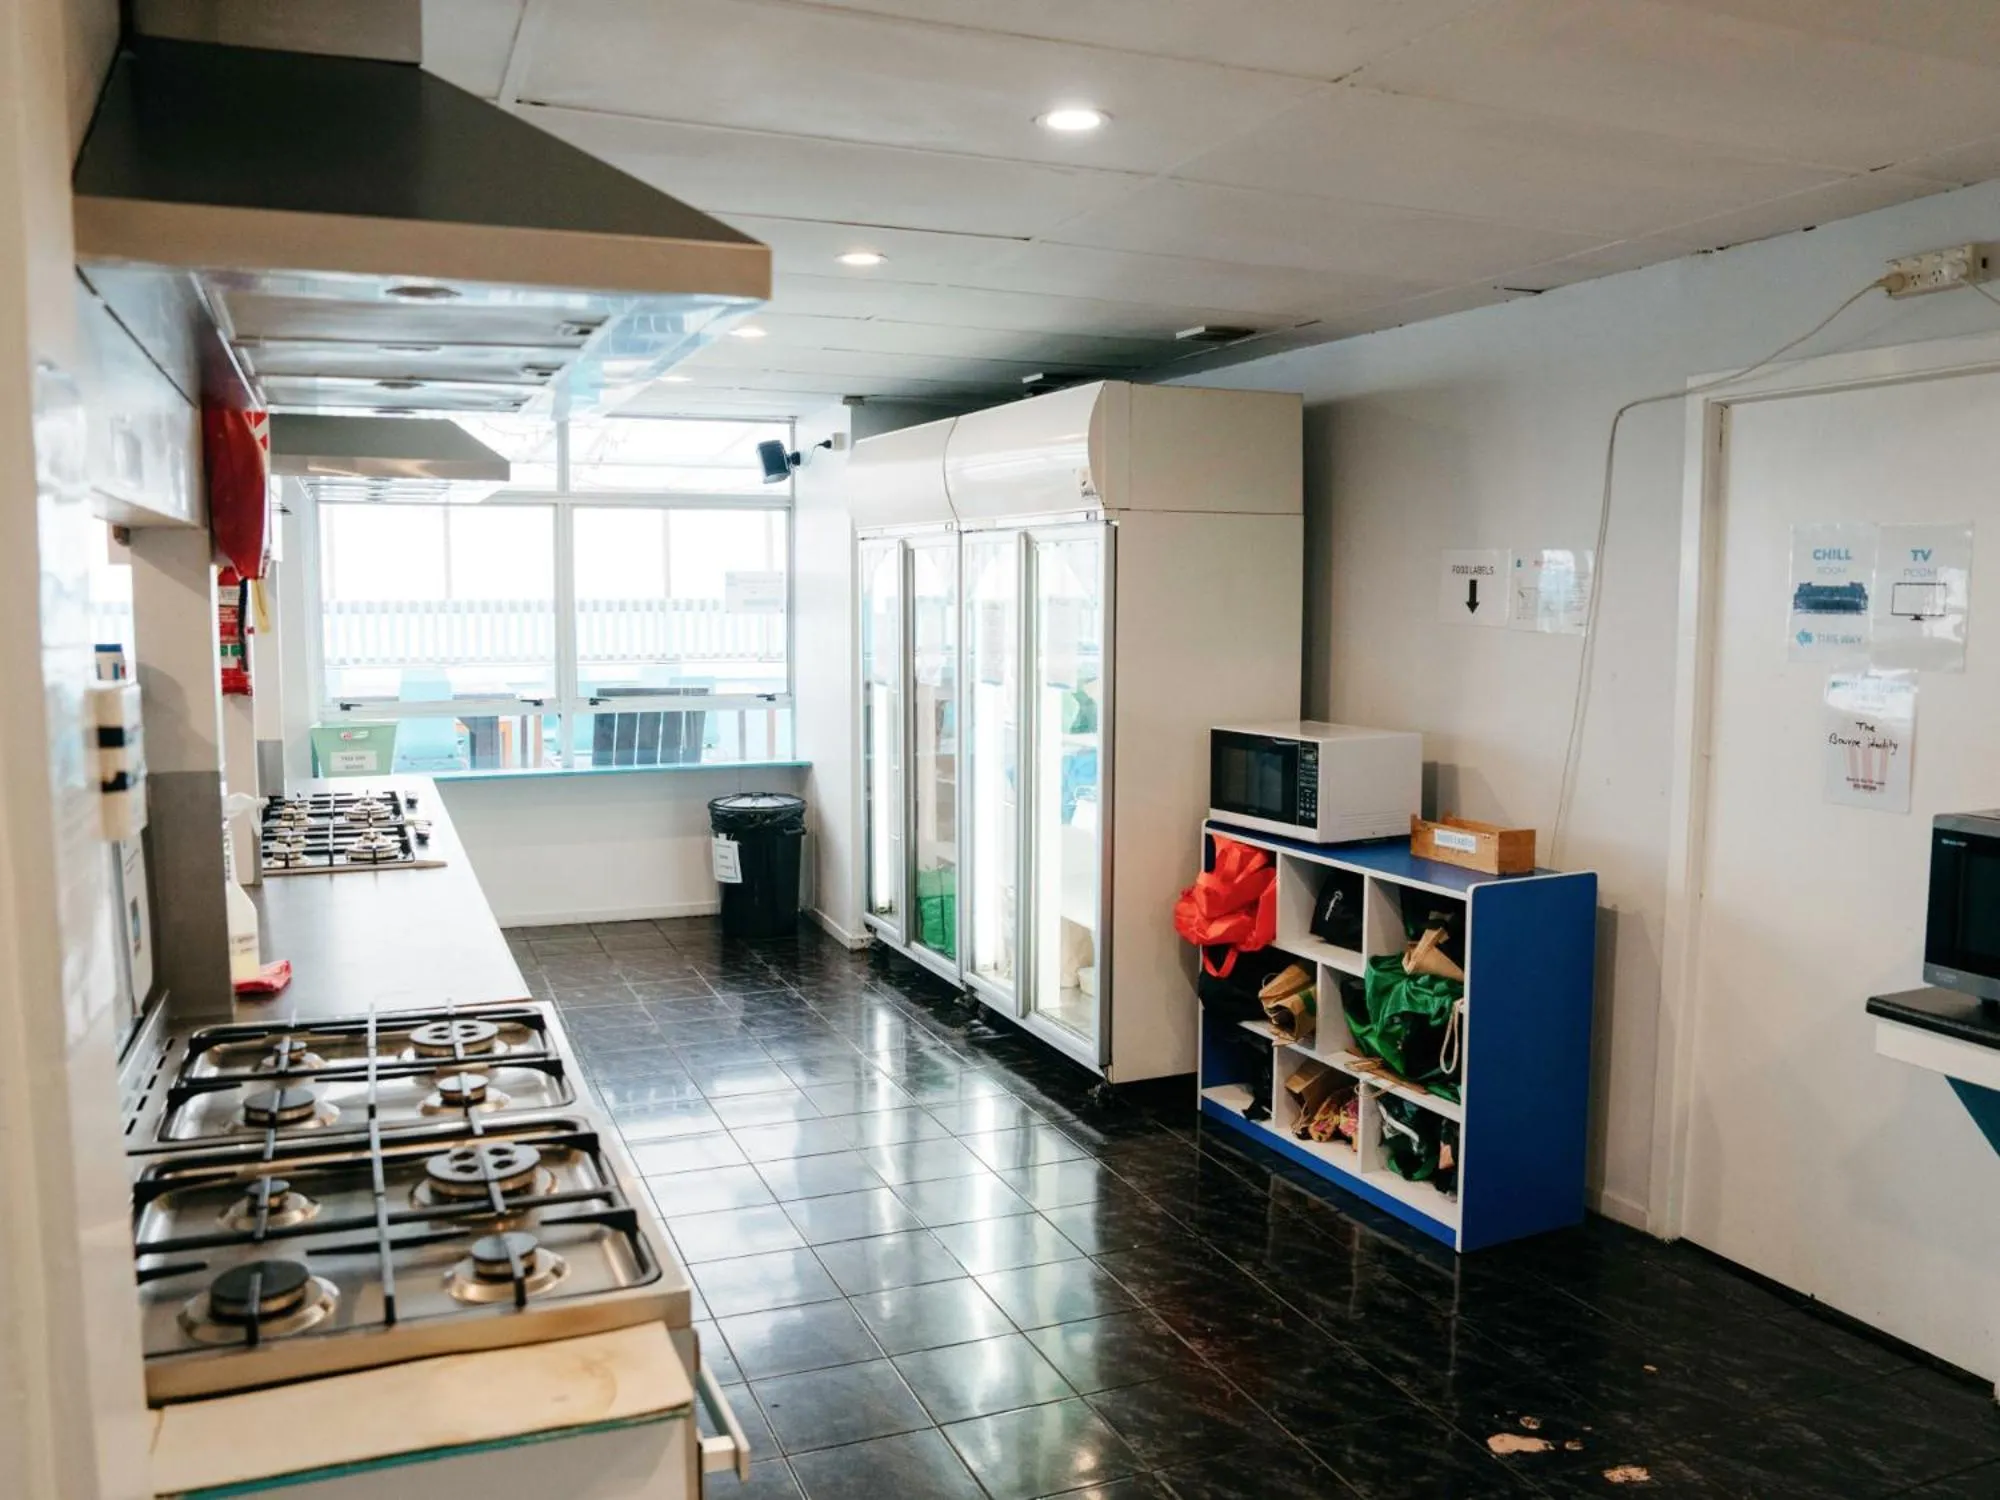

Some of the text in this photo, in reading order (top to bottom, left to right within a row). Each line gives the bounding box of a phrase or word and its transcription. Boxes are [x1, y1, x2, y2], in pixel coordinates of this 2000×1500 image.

[1812, 548, 1853, 561] CHILL
[1910, 548, 1933, 561] TV
[1855, 721, 1876, 733] The
